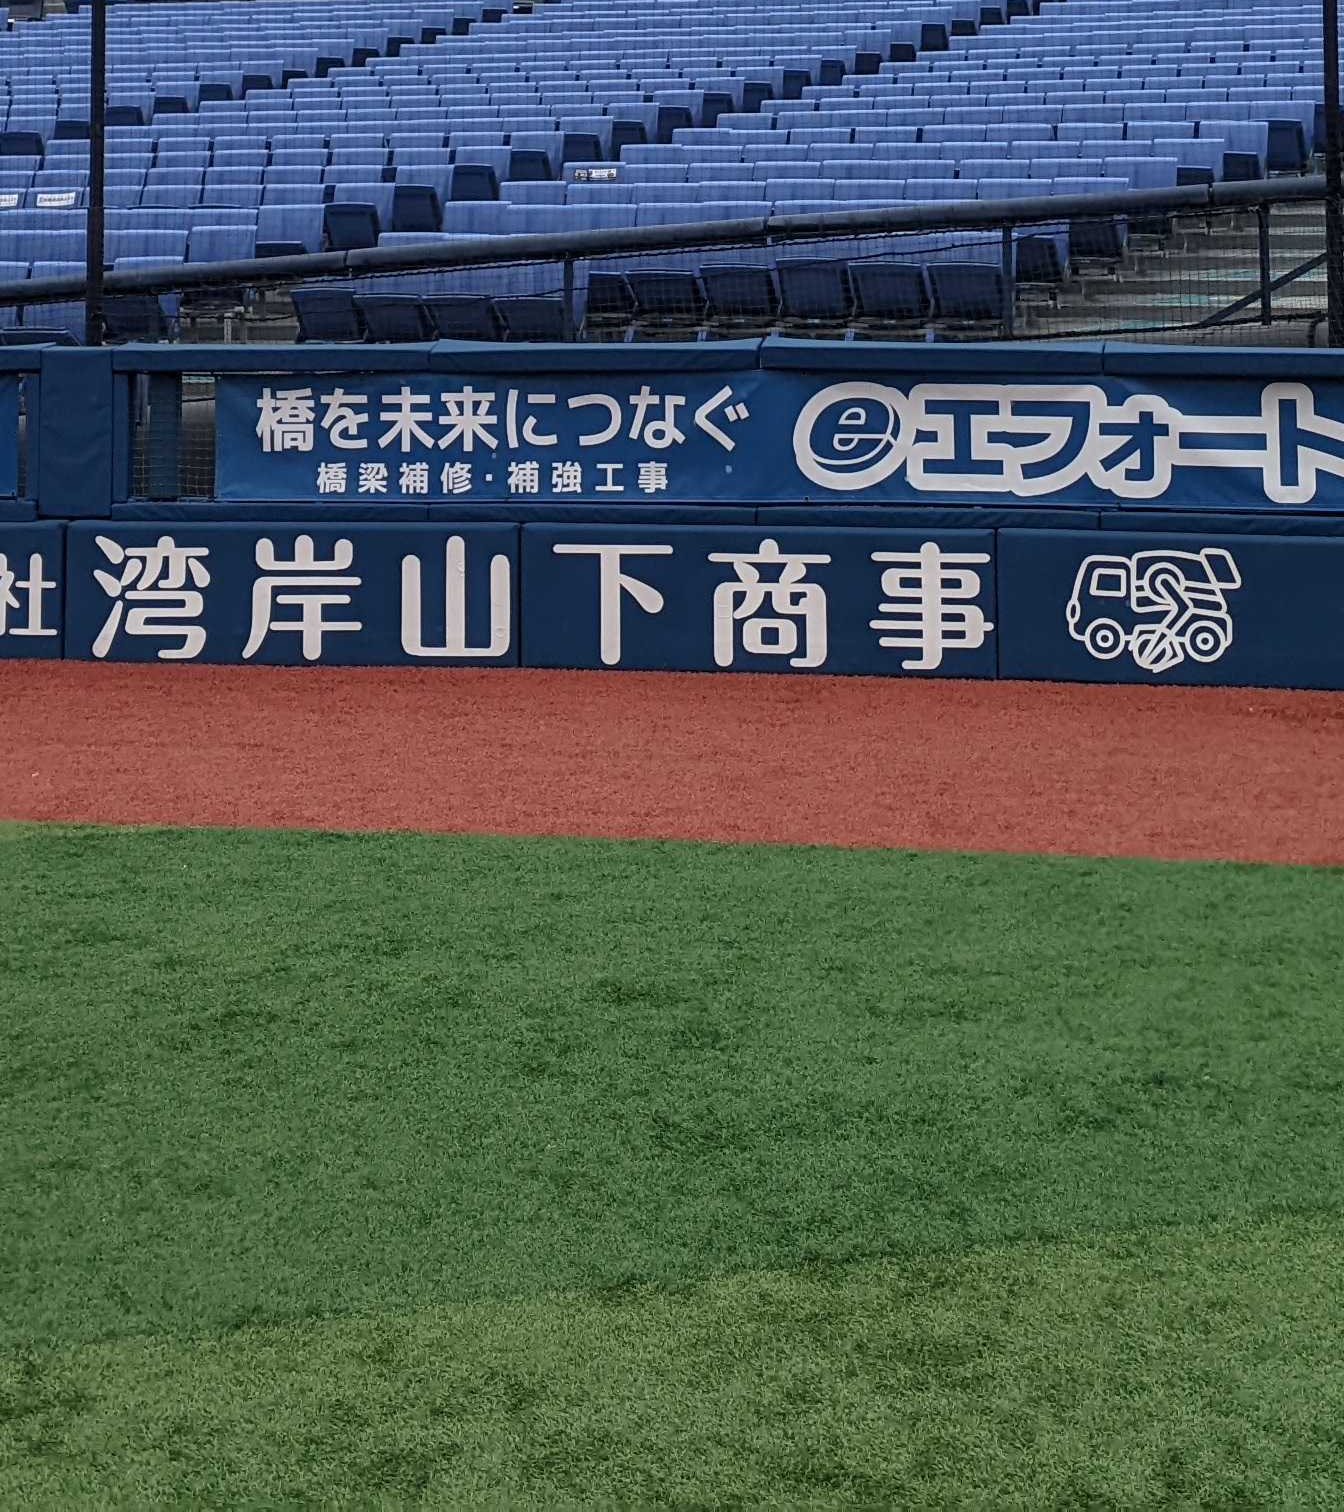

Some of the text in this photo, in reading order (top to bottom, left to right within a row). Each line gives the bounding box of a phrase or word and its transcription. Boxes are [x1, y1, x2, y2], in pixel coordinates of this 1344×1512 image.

[256, 385, 750, 452] 橋を未来につなぐ
[316, 461, 669, 495] 橋梁補修・補強工事
[91, 534, 995, 671] 湾岸山下商事
